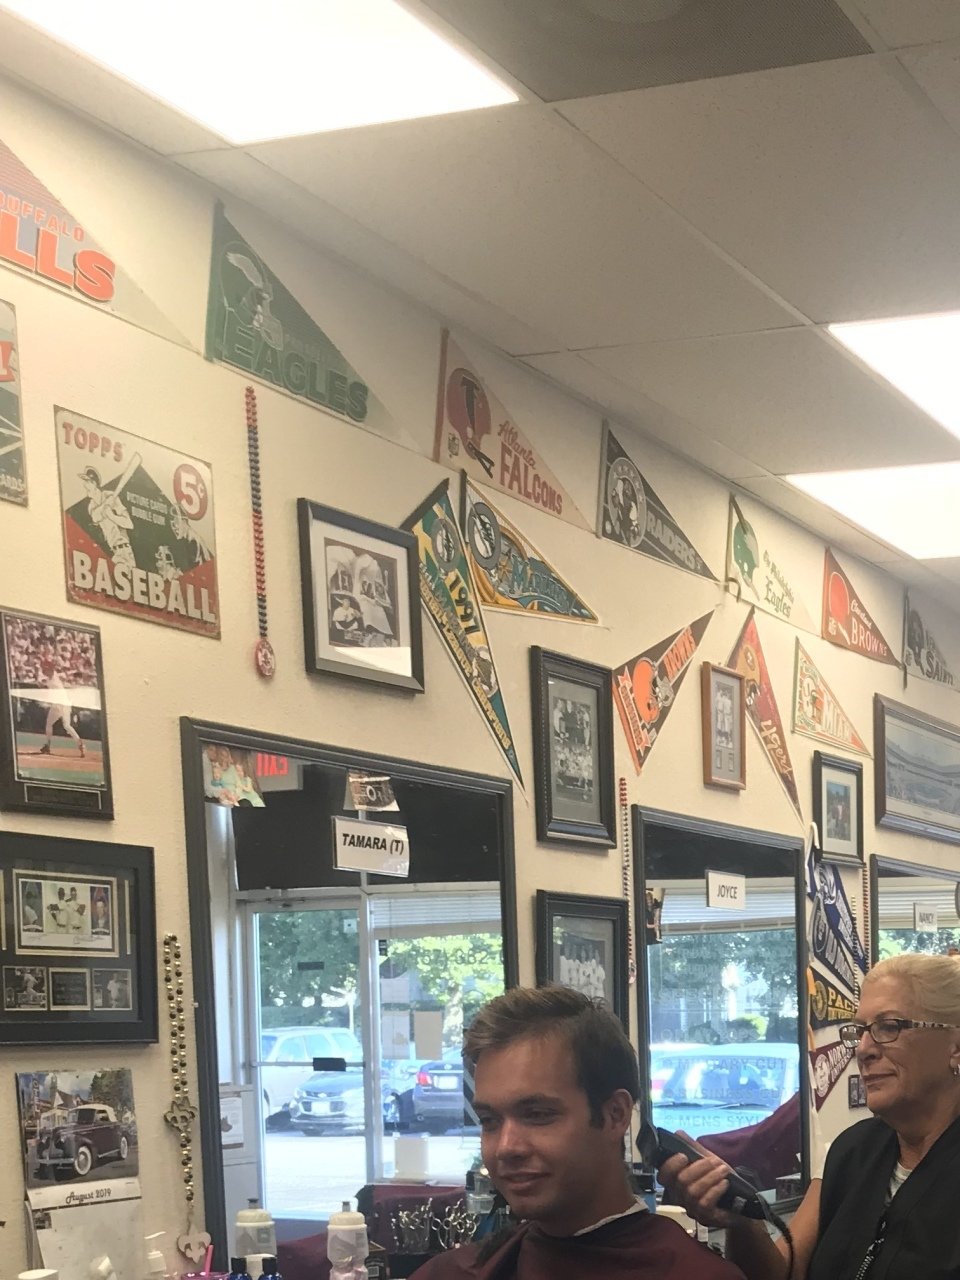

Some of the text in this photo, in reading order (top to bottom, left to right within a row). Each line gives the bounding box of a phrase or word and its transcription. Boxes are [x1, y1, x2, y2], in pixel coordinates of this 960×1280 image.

[62, 421, 123, 462] TOPPS
[497, 420, 536, 470] Atlanta
[500, 441, 563, 516] FALCONS
[647, 511, 697, 570] RAIDERS
[73, 550, 217, 623] BASEBALL
[764, 576, 792, 618] Eagles
[852, 619, 888, 657] BROWNS
[342, 833, 404, 855] TAMARA (T)
[717, 883, 738, 900] JOYCE
[65, 1187, 113, 1206] August 2019
